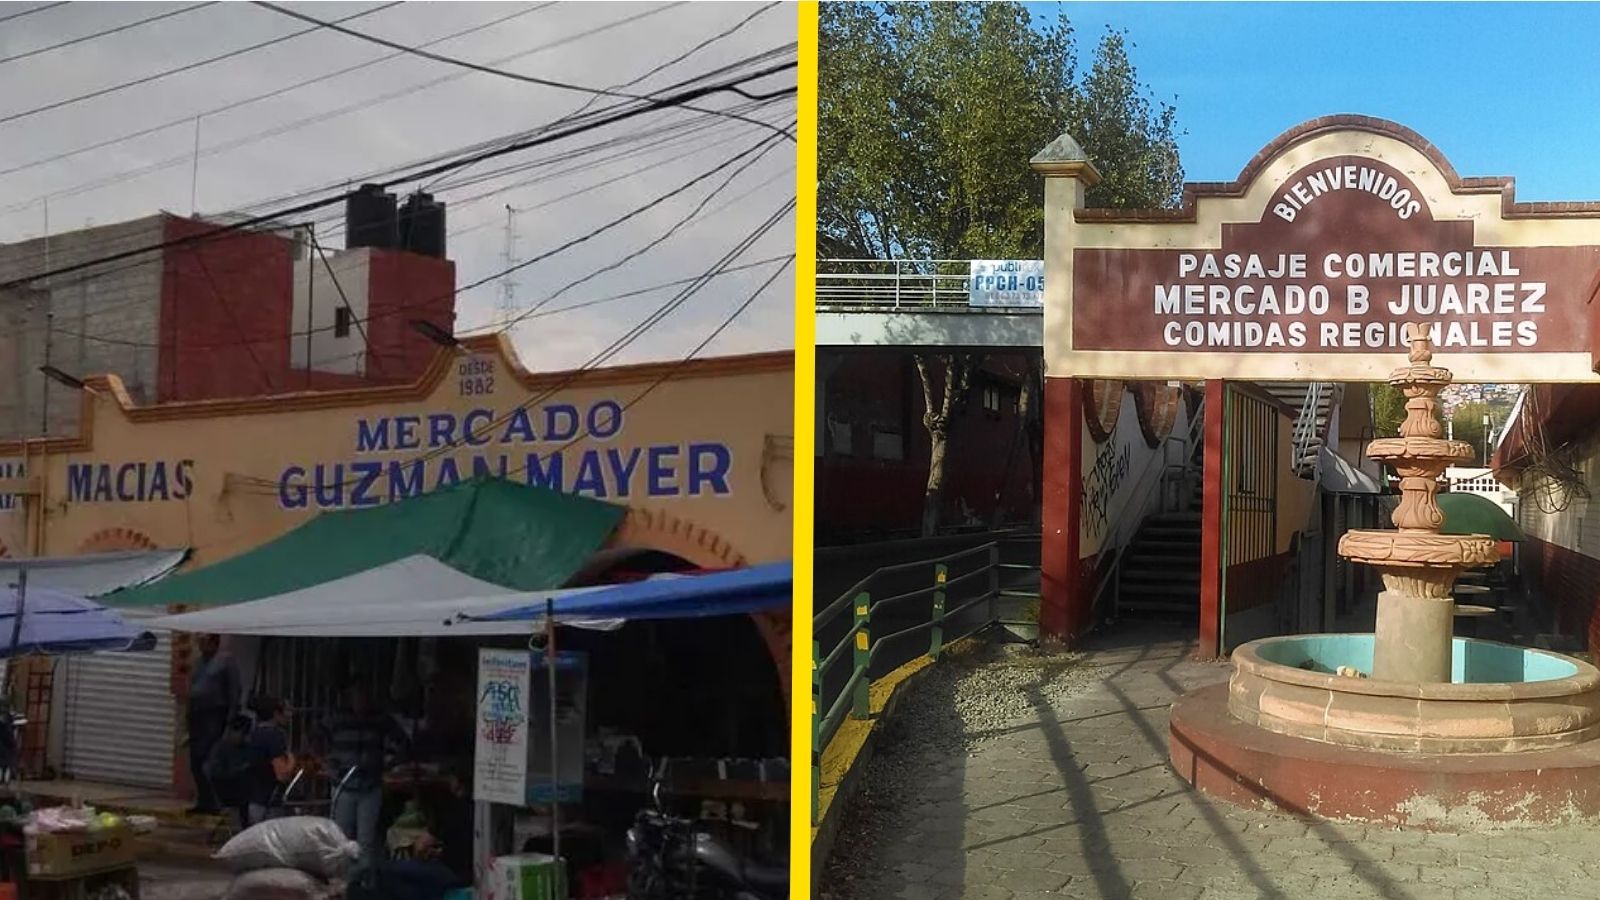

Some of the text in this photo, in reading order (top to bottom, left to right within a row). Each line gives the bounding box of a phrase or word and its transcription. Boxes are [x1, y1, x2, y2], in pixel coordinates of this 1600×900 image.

[1273, 165, 1422, 223] BIENVENIDOS
[1178, 251, 1521, 279] PASAJE COMERCIAL
[1154, 282, 1548, 315] MERCADO B JUAREZ
[1163, 321, 1307, 348] COMIDAS
[459, 360, 495, 376] DESDE
[459, 377, 495, 396] 1982
[356, 400, 624, 452] MERCADO
[66, 459, 194, 502] MACIAS
[526, 442, 732, 500] MAYER
